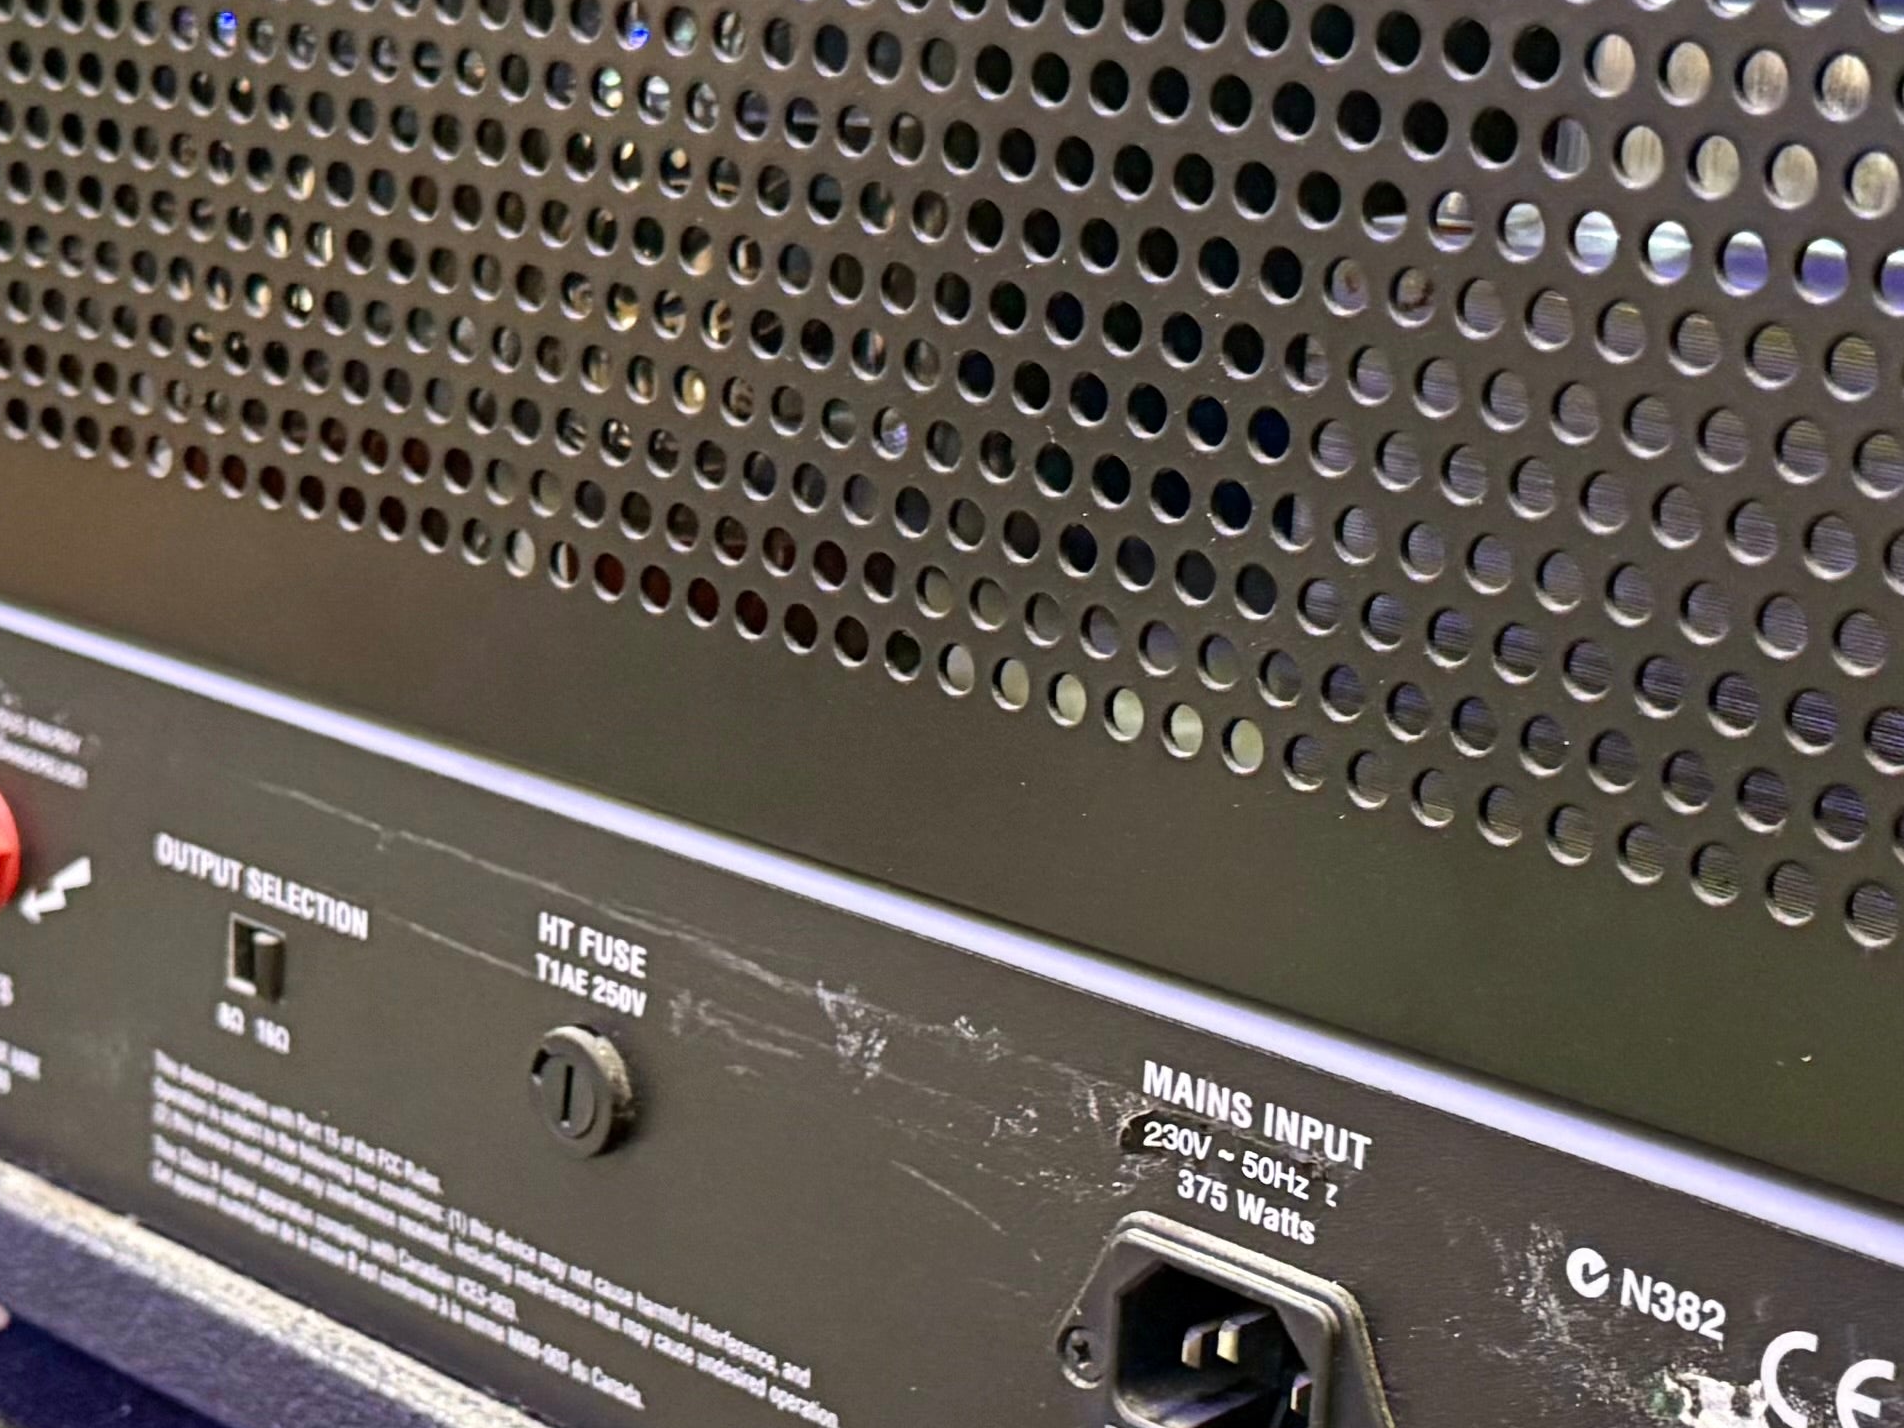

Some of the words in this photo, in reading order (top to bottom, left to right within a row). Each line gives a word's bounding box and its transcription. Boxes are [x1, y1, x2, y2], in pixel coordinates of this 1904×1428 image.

[154, 832, 244, 893] OUTPUT
[244, 866, 369, 942] SELECTION
[538, 911, 576, 951] HT
[578, 925, 648, 979] FUSE
[534, 952, 590, 997] T1AE
[590, 974, 648, 1018] 250V
[1143, 1059, 1253, 1130] MAINS
[1262, 1102, 1373, 1170] INPUT
[1143, 1120, 1213, 1161] 230V
[1241, 1149, 1311, 1201] 50Hz
[1176, 1168, 1228, 1213] 375
[1236, 1188, 1316, 1246] Watts
[1620, 1267, 1727, 1342] N382
